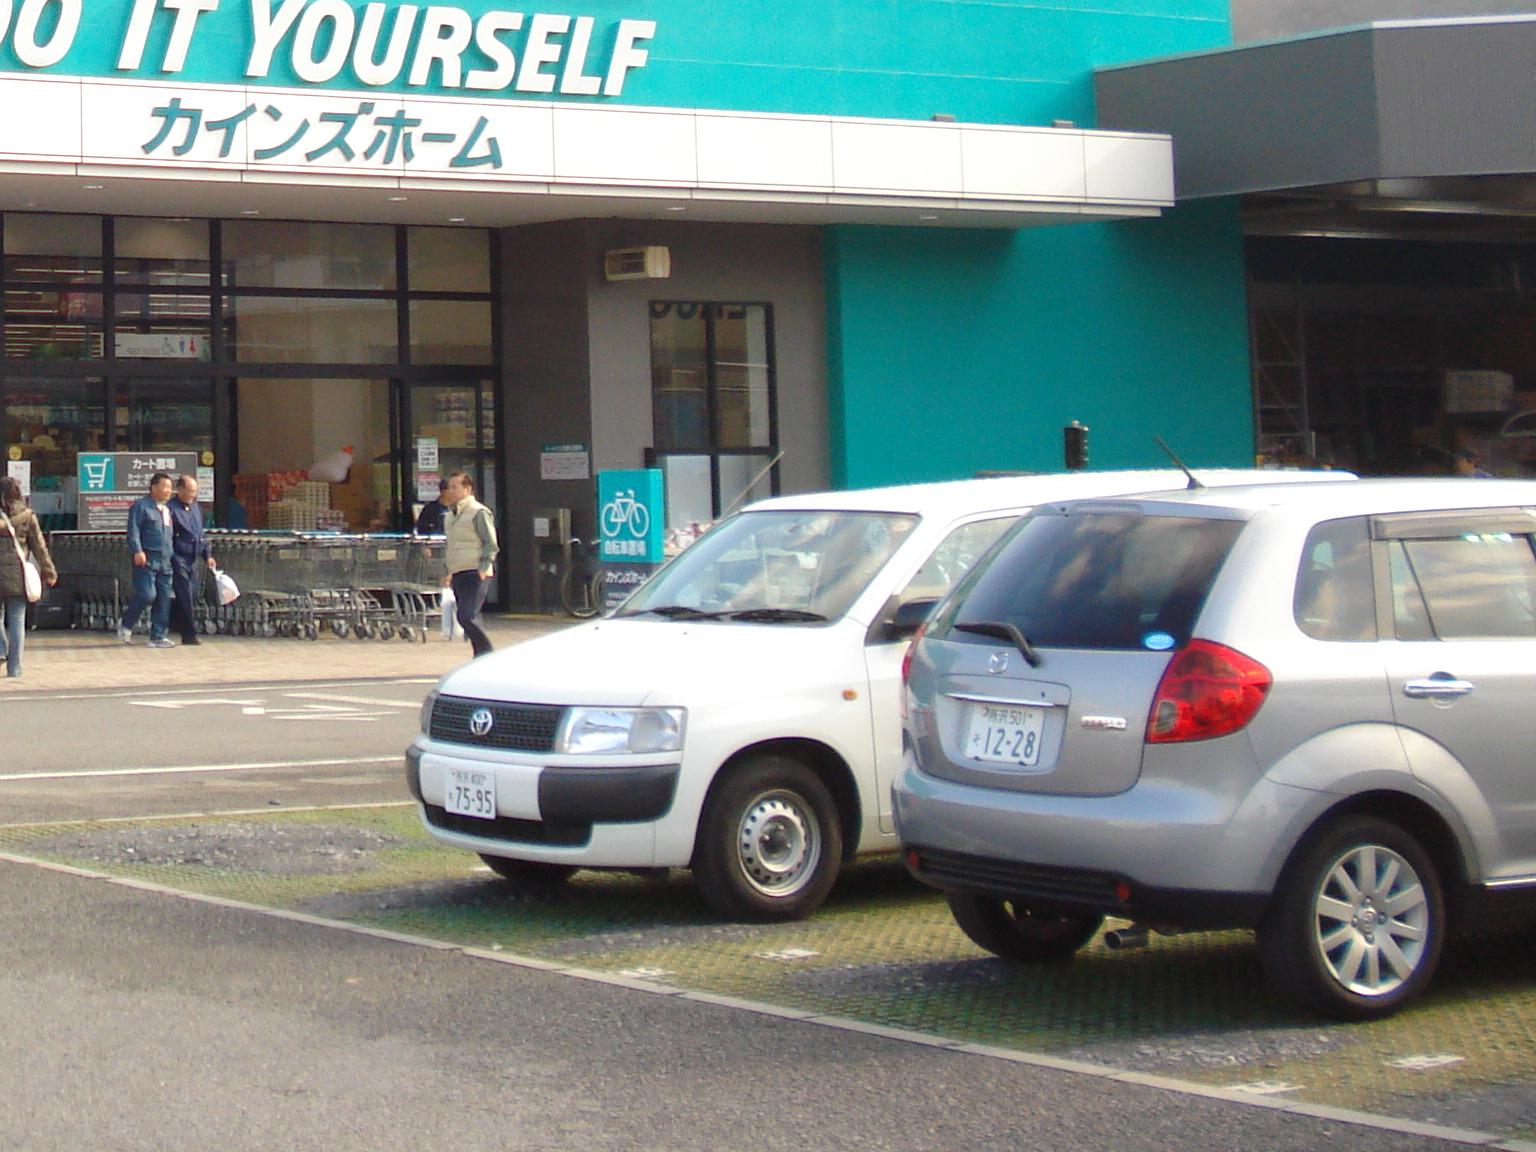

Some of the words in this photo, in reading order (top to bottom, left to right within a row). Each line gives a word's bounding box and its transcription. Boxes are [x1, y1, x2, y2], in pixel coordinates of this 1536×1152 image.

[141, 97, 504, 171] カインズホーム
